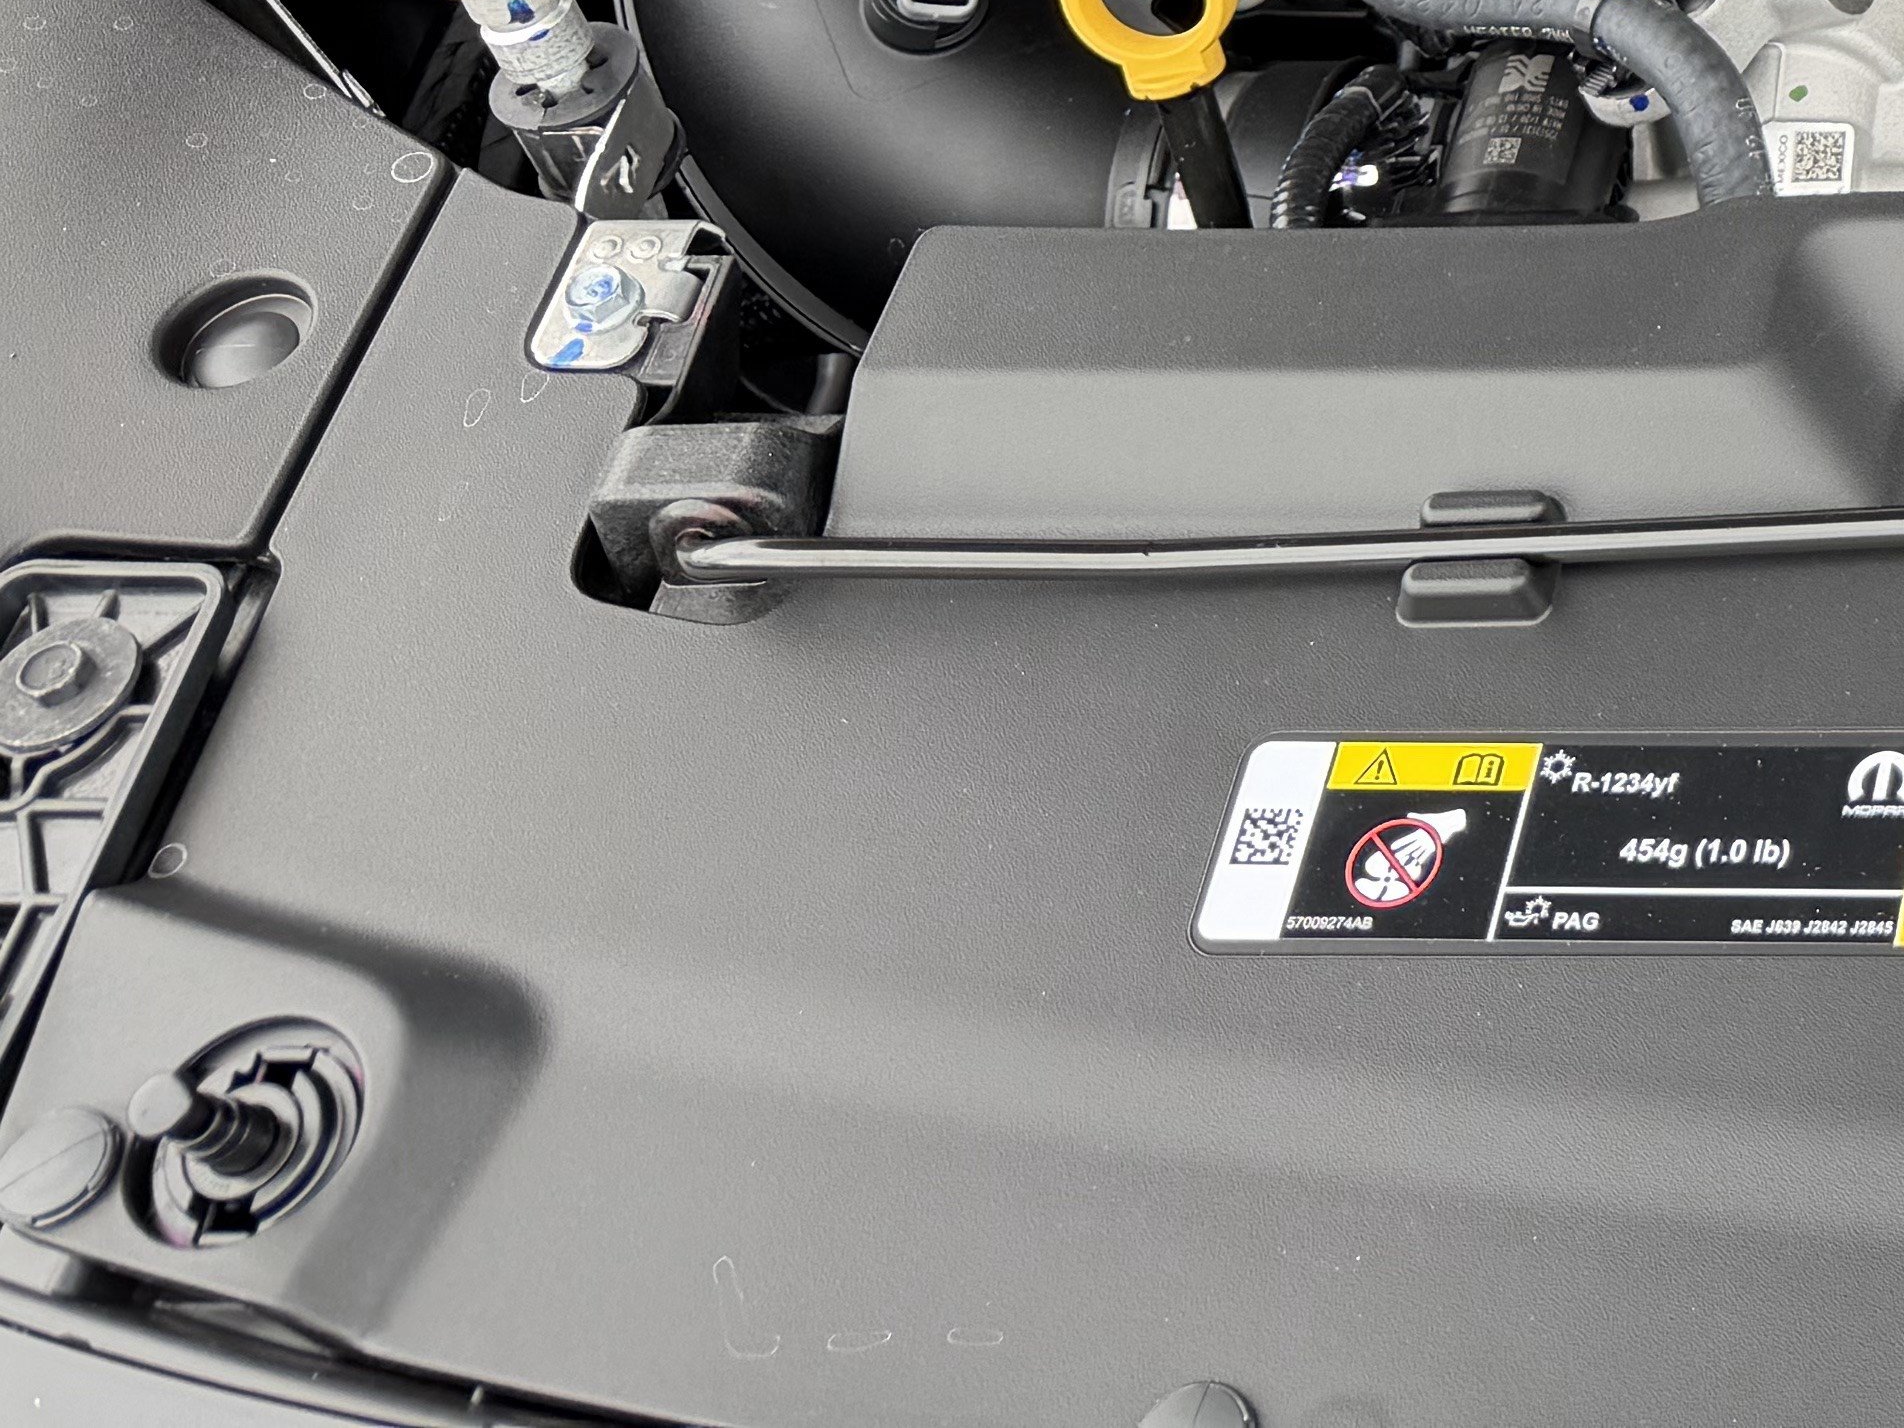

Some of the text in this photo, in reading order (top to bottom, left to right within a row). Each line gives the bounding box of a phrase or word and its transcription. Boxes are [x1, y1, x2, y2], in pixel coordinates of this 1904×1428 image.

[1776, 133, 1789, 185] MEXICO
[1571, 771, 1680, 798] R-1234yf
[1619, 838, 1791, 870] 454g (1.0 lb)
[1286, 916, 1374, 930] 57009274AB
[1551, 912, 1601, 931] PAG
[1730, 919, 1894, 935] SAE J639 J2842 J2845
